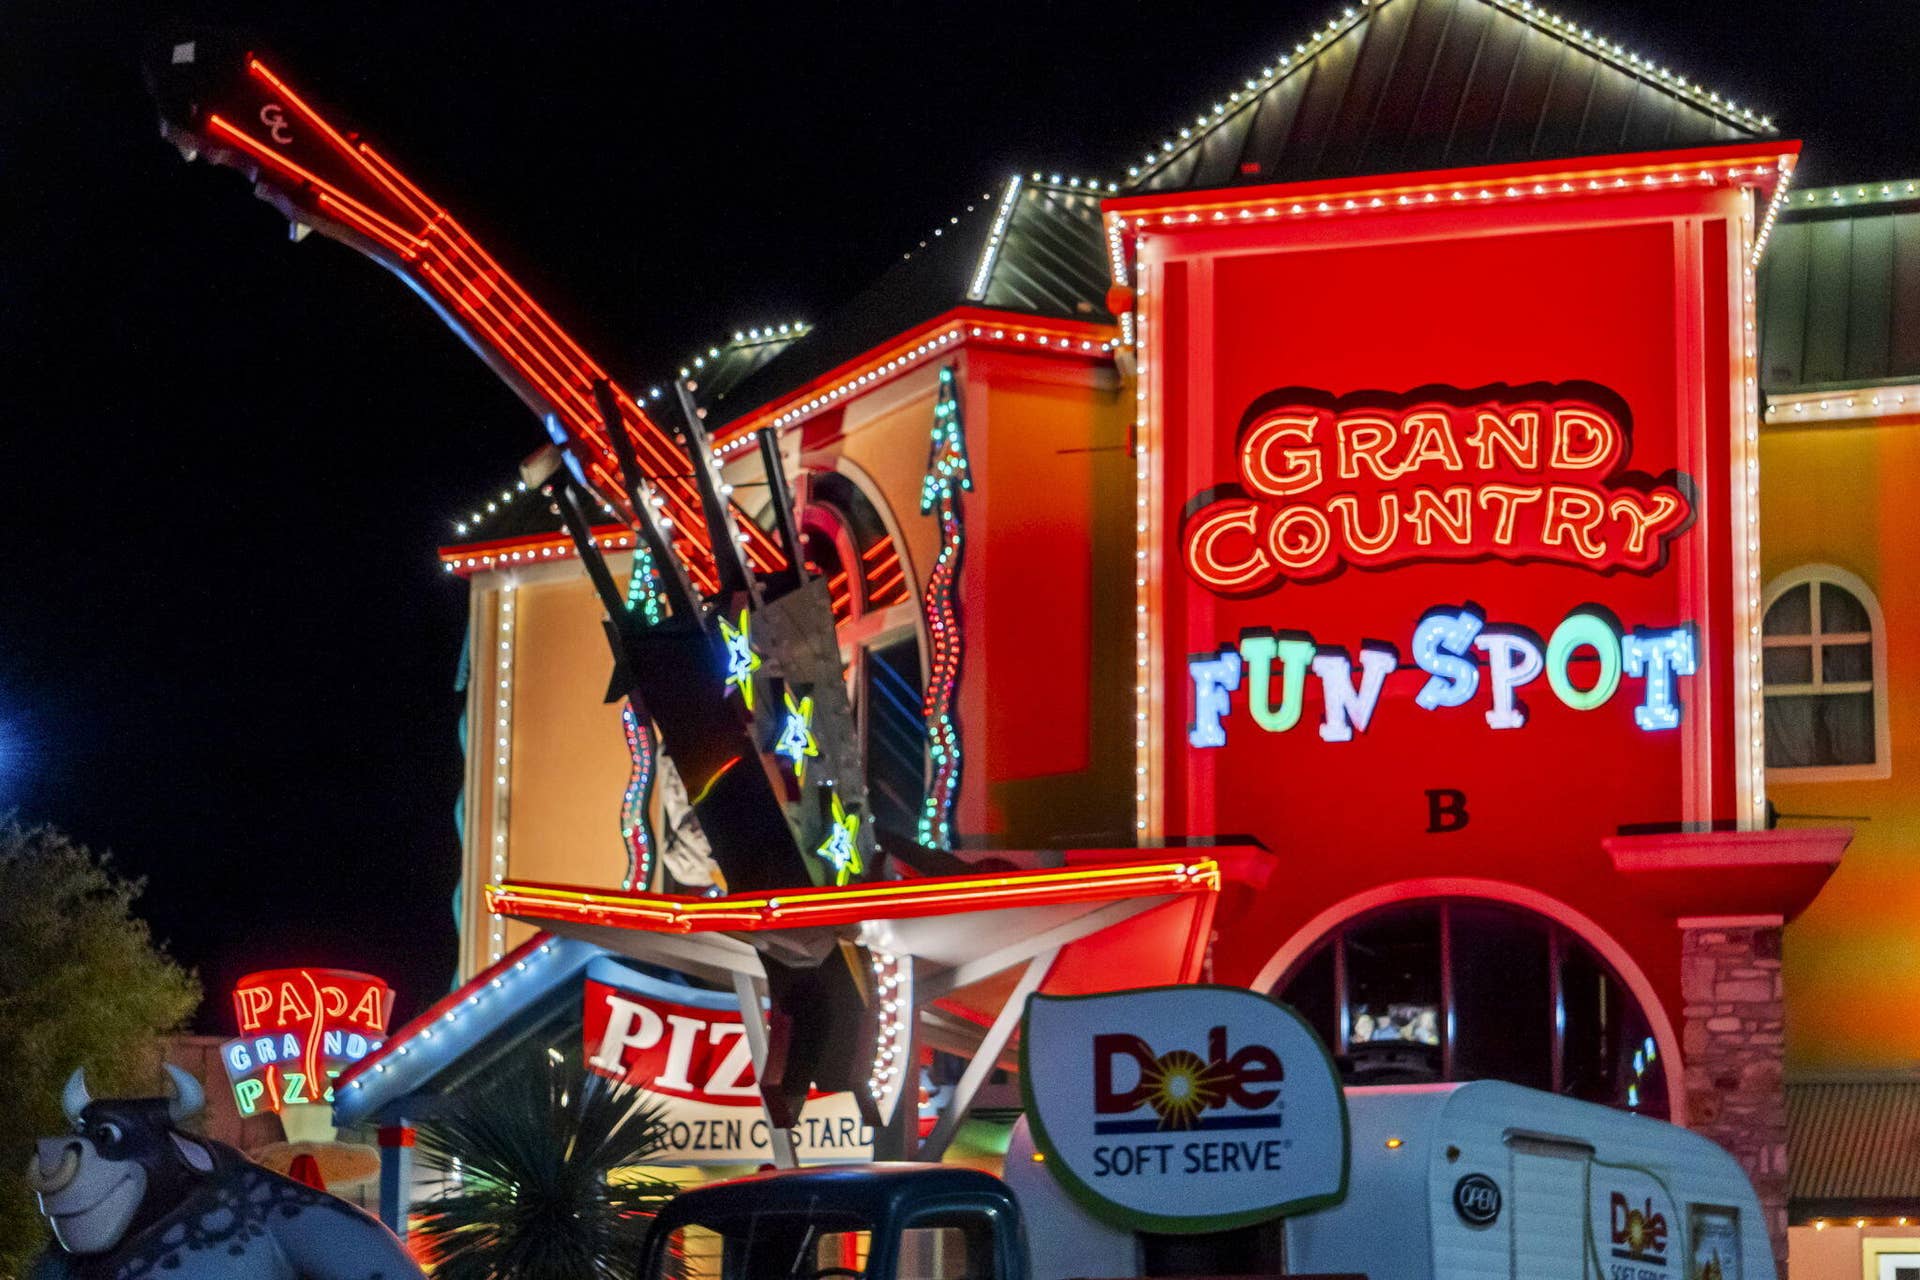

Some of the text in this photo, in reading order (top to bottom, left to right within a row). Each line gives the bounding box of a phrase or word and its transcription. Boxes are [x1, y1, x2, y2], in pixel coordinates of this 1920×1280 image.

[1242, 409, 1614, 496] GRAND
[1189, 486, 1677, 585] COUNTRY
[1187, 607, 1696, 748] FUN SPOT
[1424, 788, 1470, 834] B
[236, 981, 384, 1031] PAPA
[230, 1030, 382, 1071] GRAND
[1093, 1026, 1285, 1114] Dole
[648, 1117, 874, 1150] ROZEN CSTARD
[1093, 1140, 1281, 1177] SOFT SERVE
[1611, 1191, 1667, 1253] Dole
